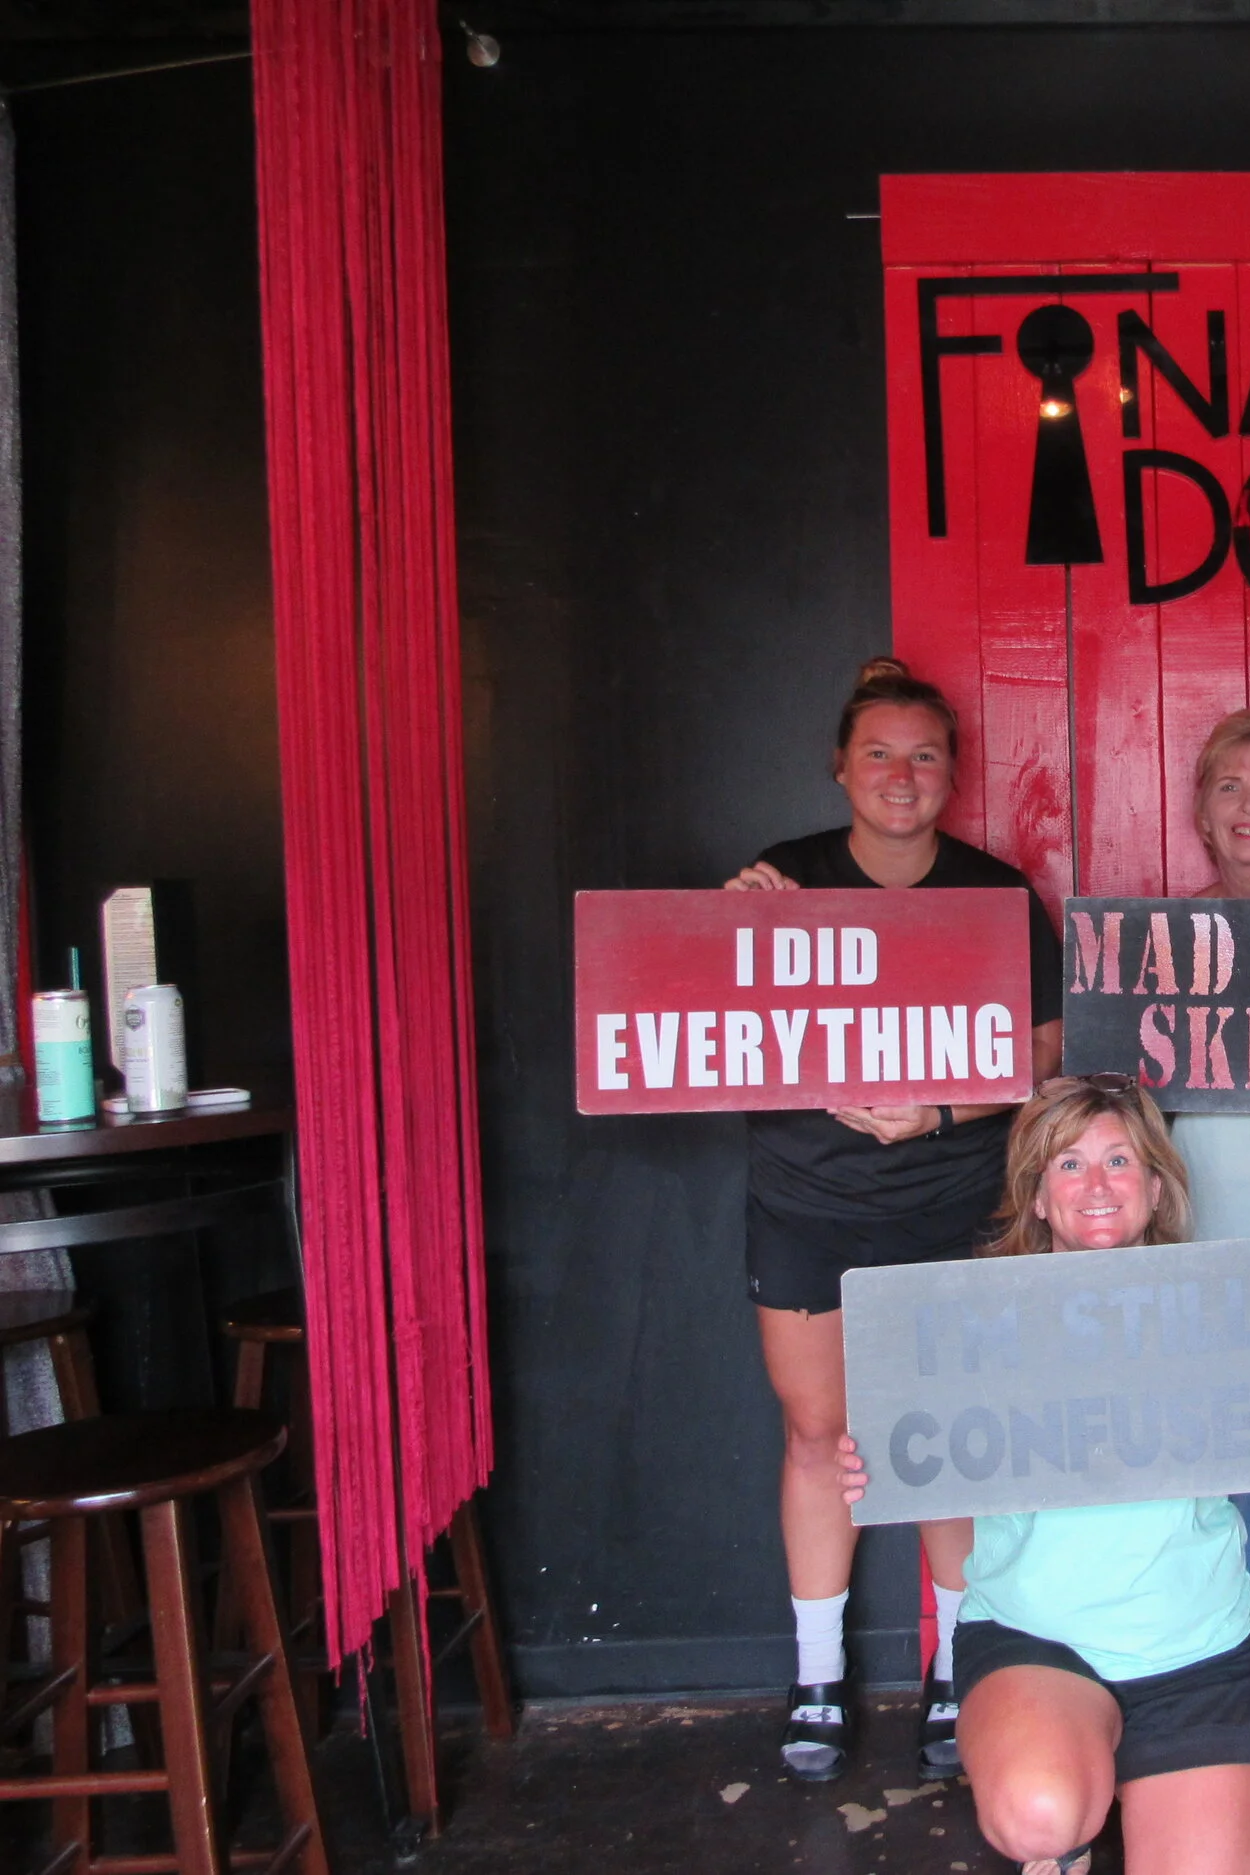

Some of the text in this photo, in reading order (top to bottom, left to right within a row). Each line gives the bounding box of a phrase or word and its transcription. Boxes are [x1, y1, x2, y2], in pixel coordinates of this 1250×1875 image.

[736, 927, 878, 987] I DID
[1070, 911, 1235, 995] MAD
[597, 1003, 1014, 1091] EVERYTHING
